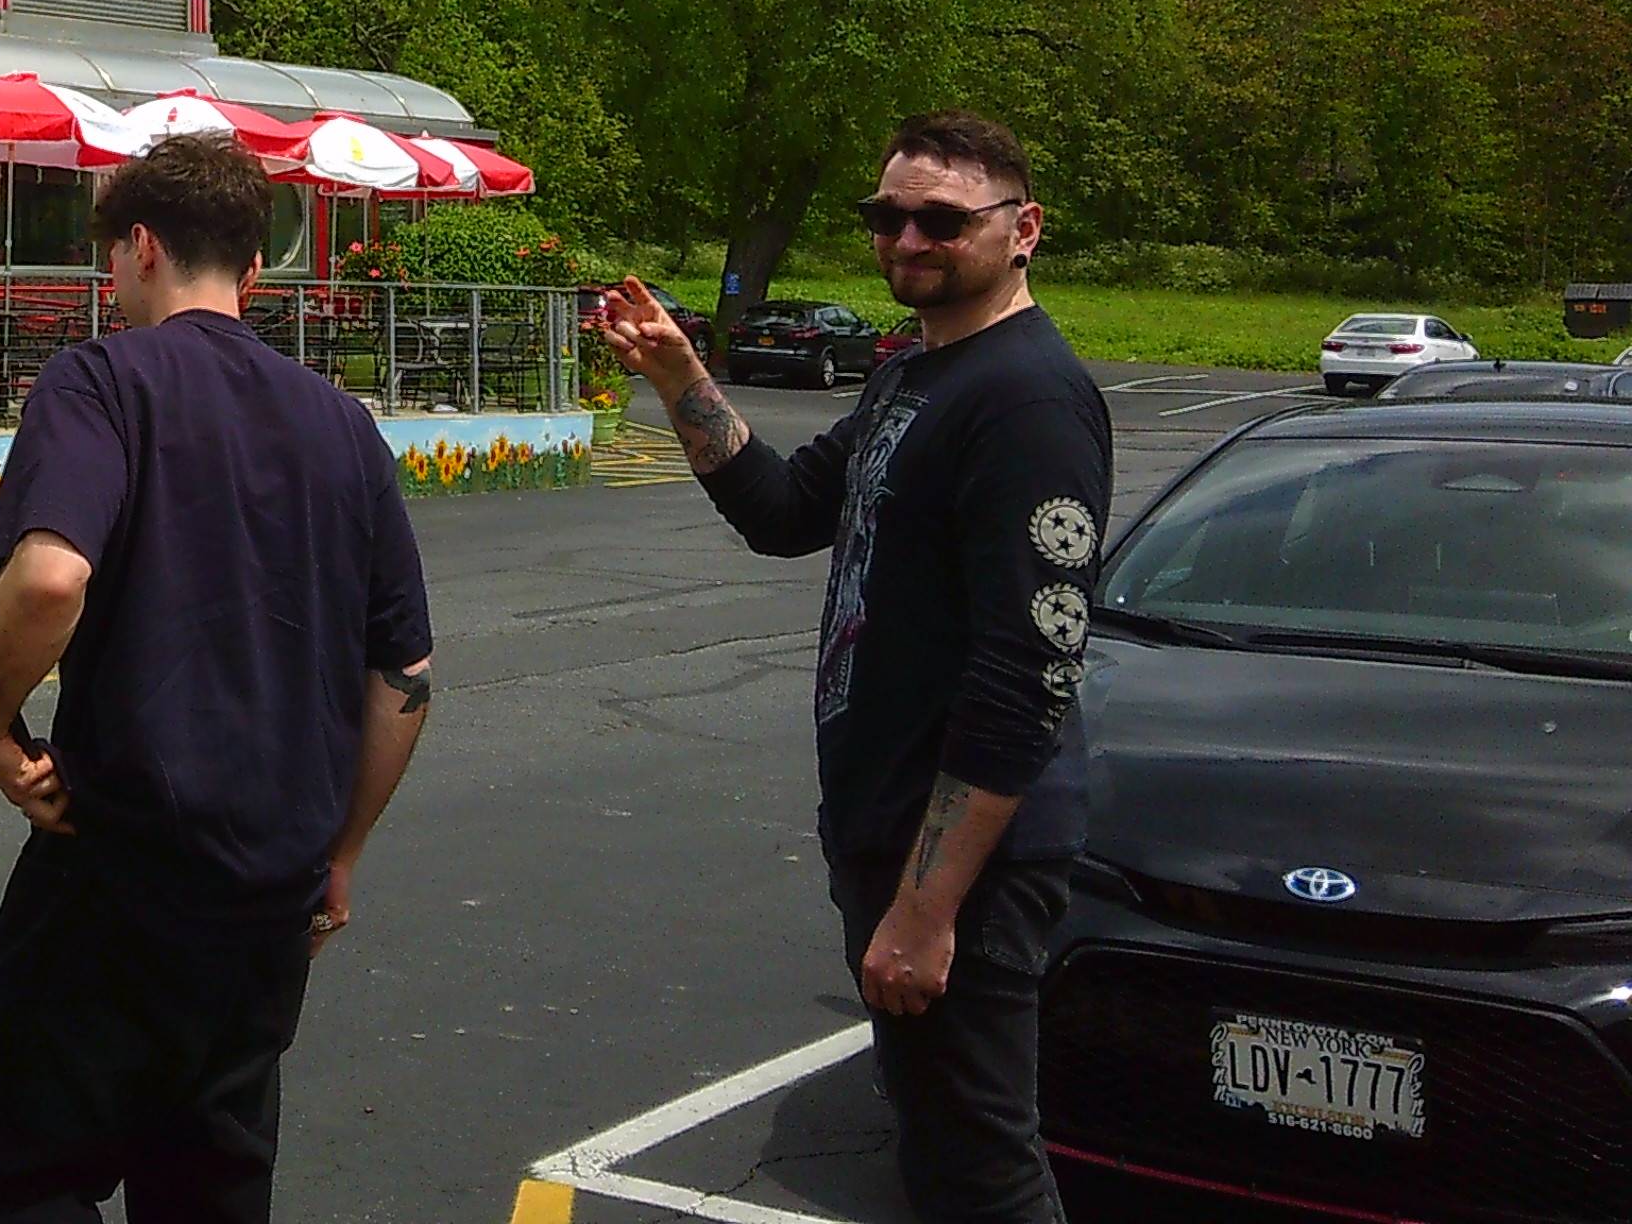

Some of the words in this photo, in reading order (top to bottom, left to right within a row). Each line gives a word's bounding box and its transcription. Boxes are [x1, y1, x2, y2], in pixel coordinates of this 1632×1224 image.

[1264, 1026, 1310, 1049] NEW
[1315, 1032, 1371, 1059] YORK
[1228, 1040, 1291, 1097] LDV
[1319, 1055, 1406, 1115] 1777
[1268, 1112, 1374, 1141] 516-621-8600
